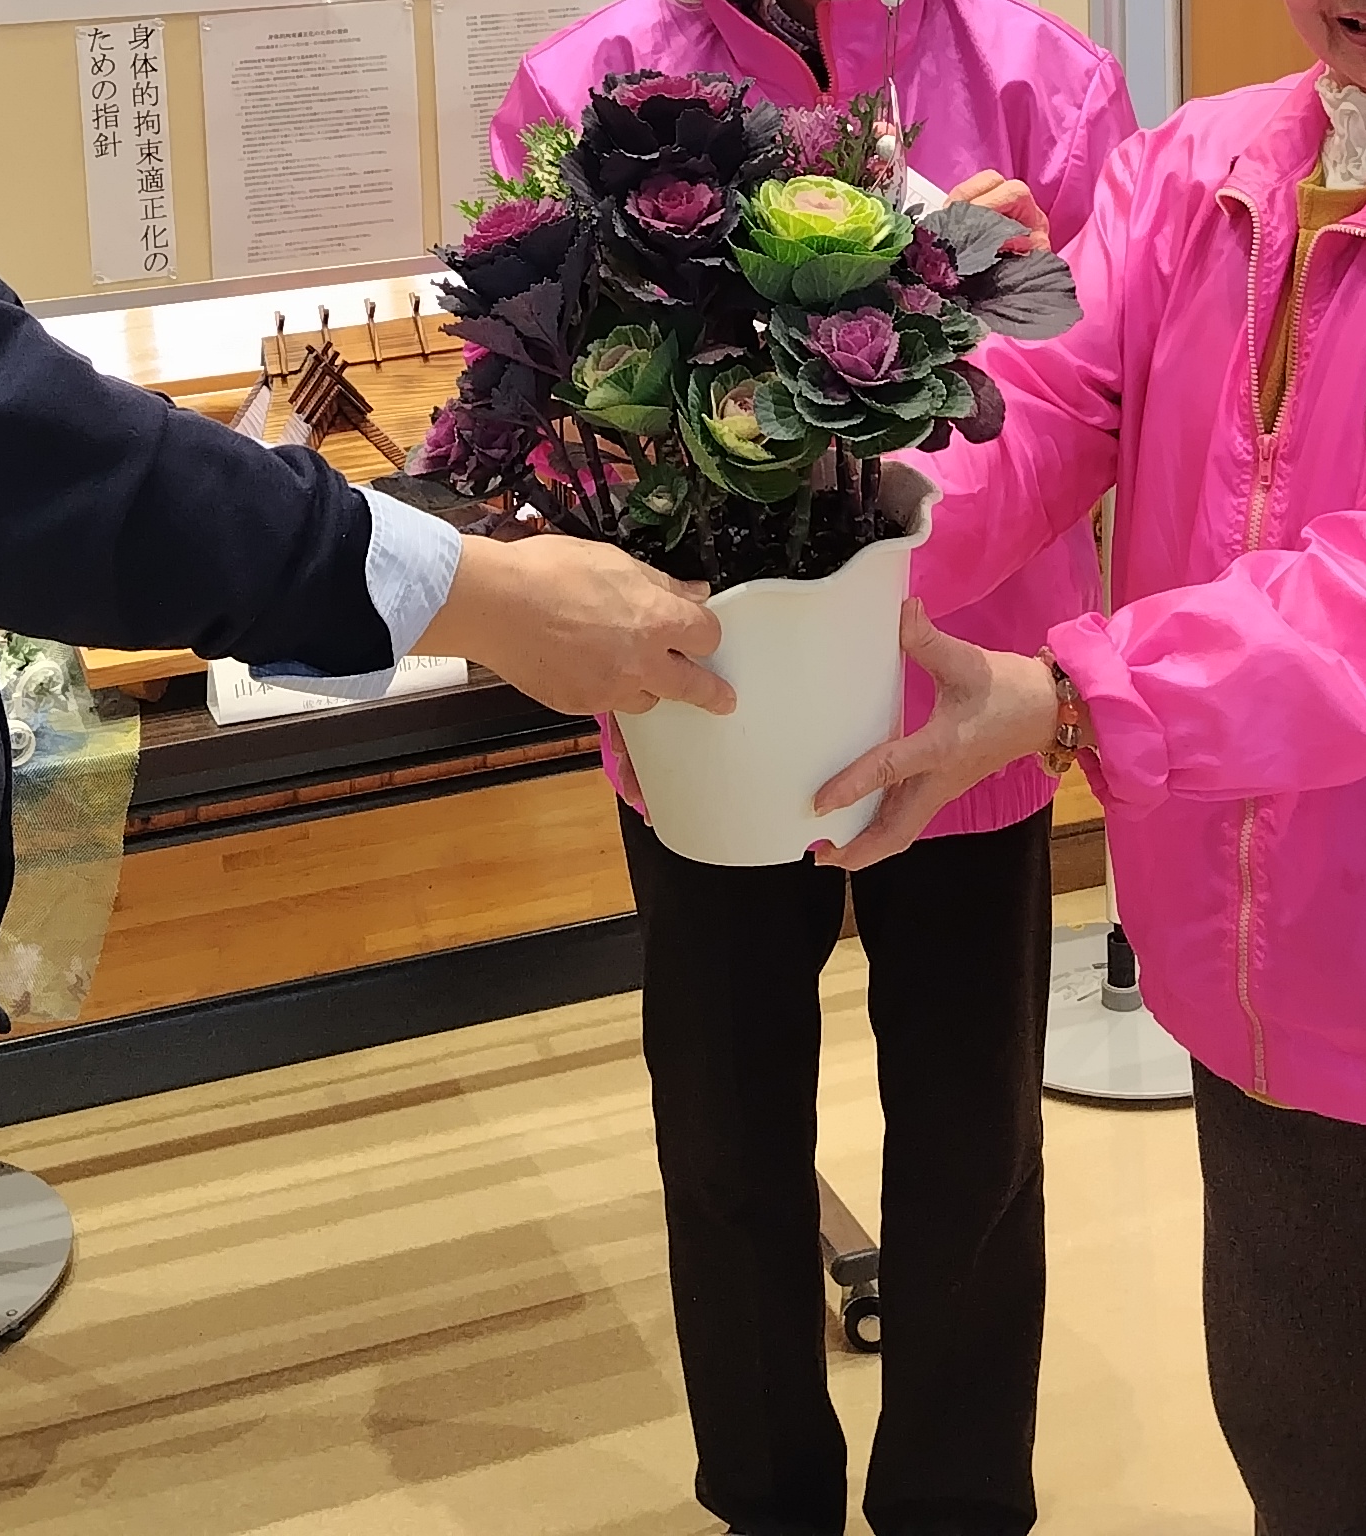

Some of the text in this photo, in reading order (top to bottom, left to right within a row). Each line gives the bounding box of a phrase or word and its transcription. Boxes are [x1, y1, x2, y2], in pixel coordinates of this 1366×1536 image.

[87, 26, 123, 158] ための指針
[128, 22, 170, 273] 身体的拘束適正化の
